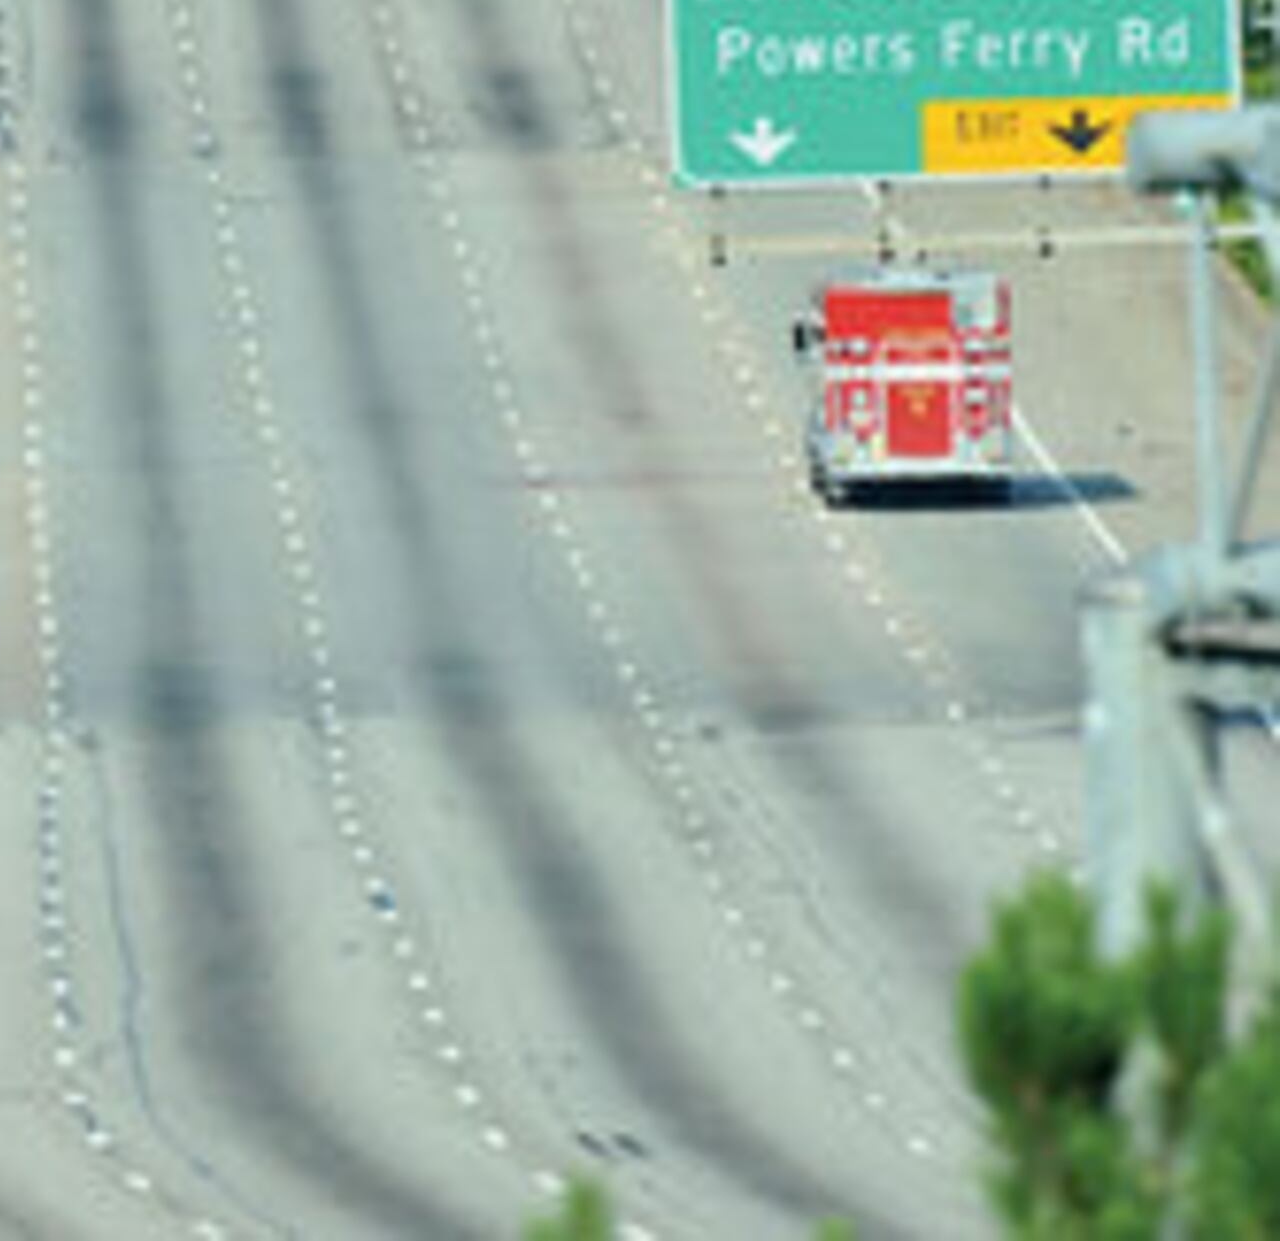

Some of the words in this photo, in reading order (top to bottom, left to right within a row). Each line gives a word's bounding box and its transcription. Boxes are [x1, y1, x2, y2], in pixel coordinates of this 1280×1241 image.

[716, 25, 917, 76] Powers
[943, 19, 1090, 78] Ferry
[1119, 17, 1190, 64] Rd
